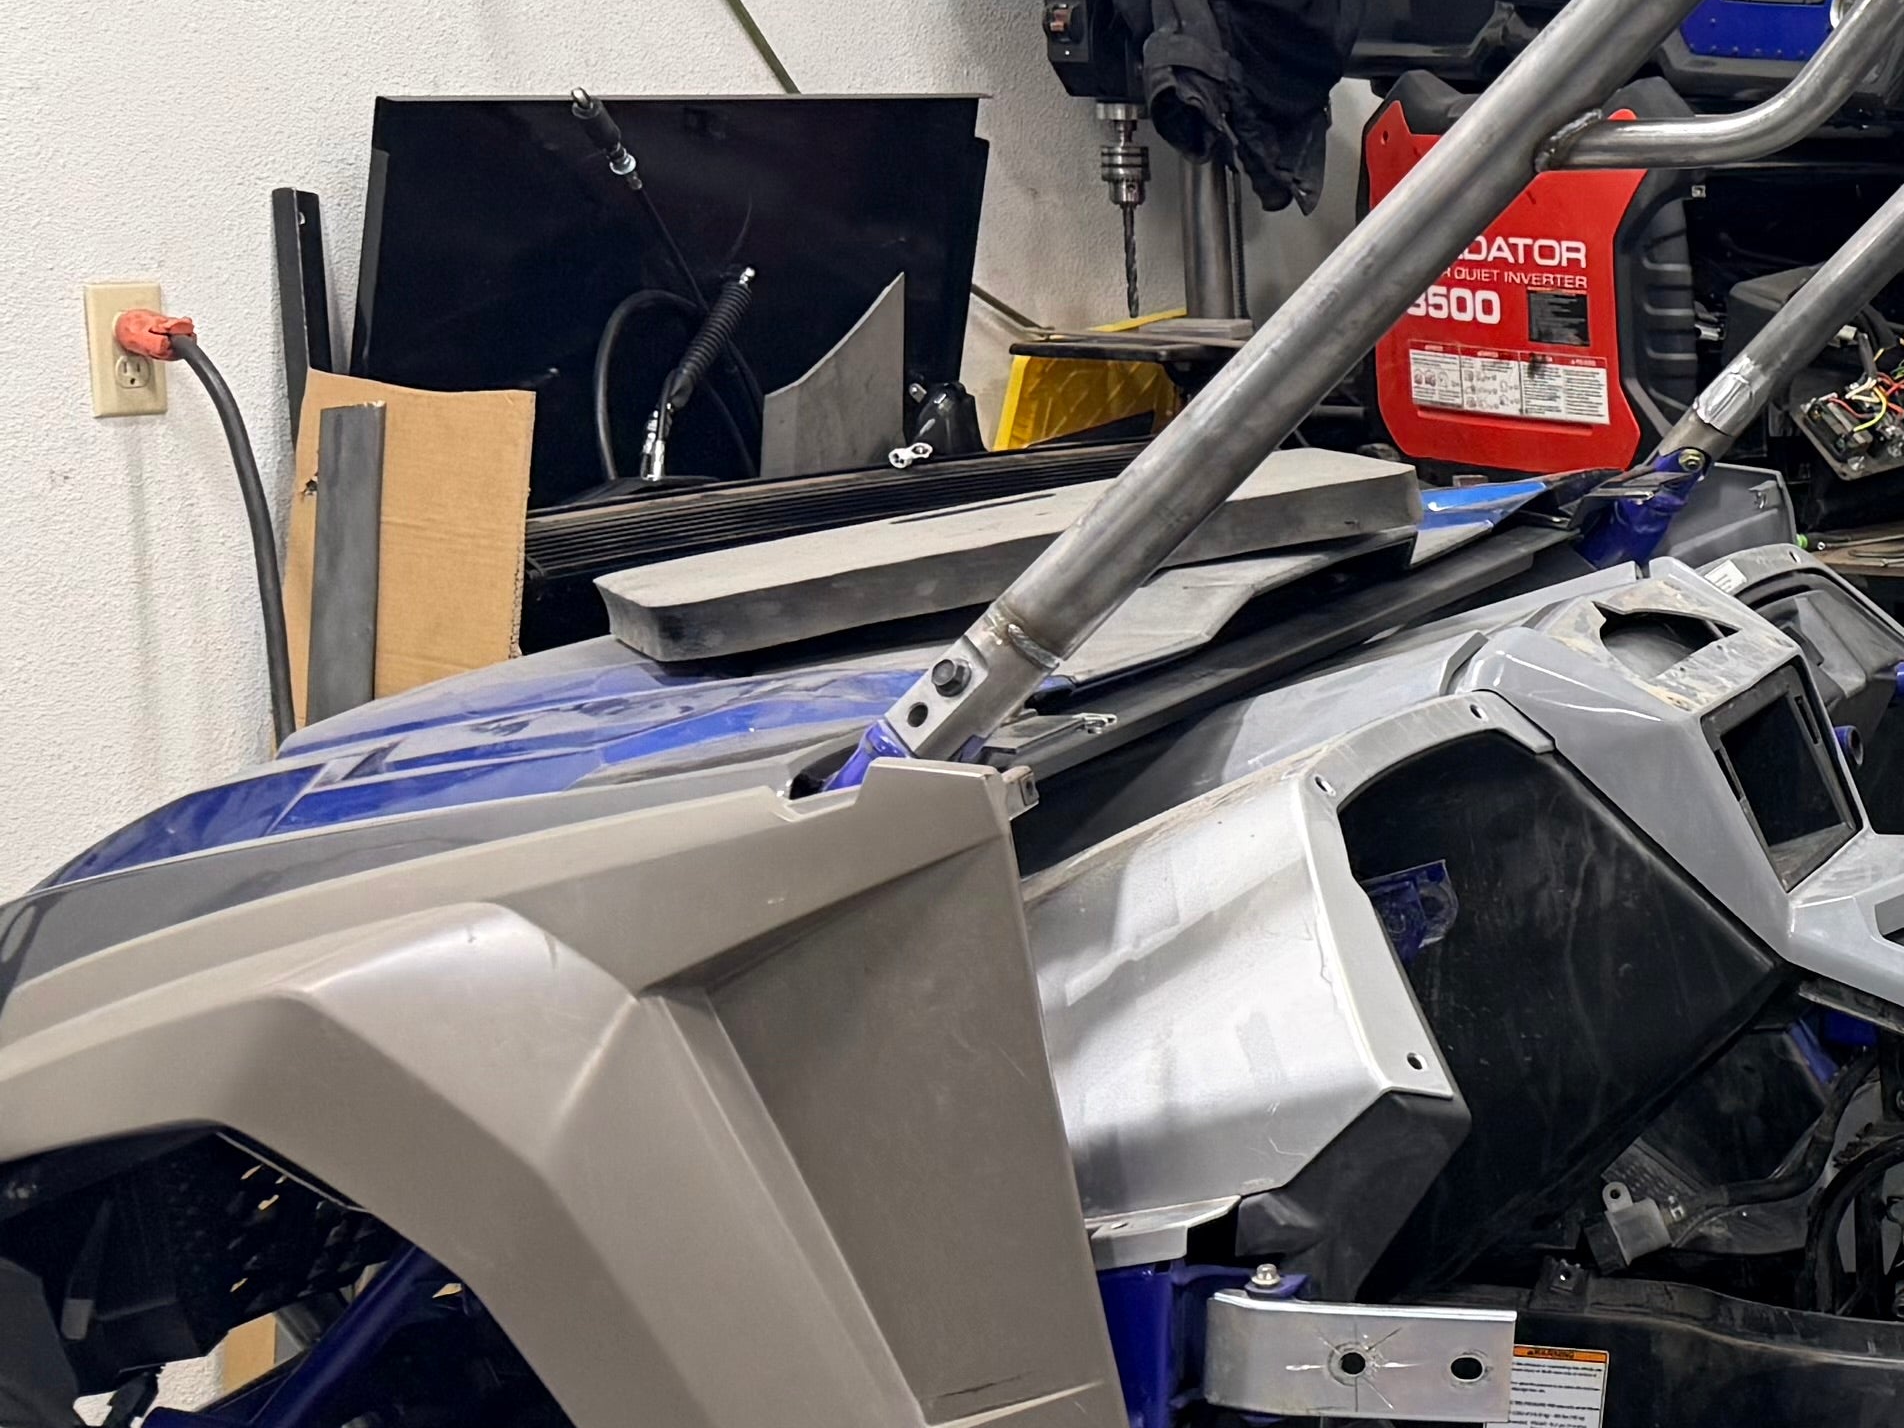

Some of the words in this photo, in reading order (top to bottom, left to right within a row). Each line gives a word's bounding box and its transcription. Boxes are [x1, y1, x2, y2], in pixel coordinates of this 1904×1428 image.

[1458, 235, 1588, 269] DATOR
[1454, 267, 1500, 283] QUIET
[1504, 270, 1588, 289] INVERTER
